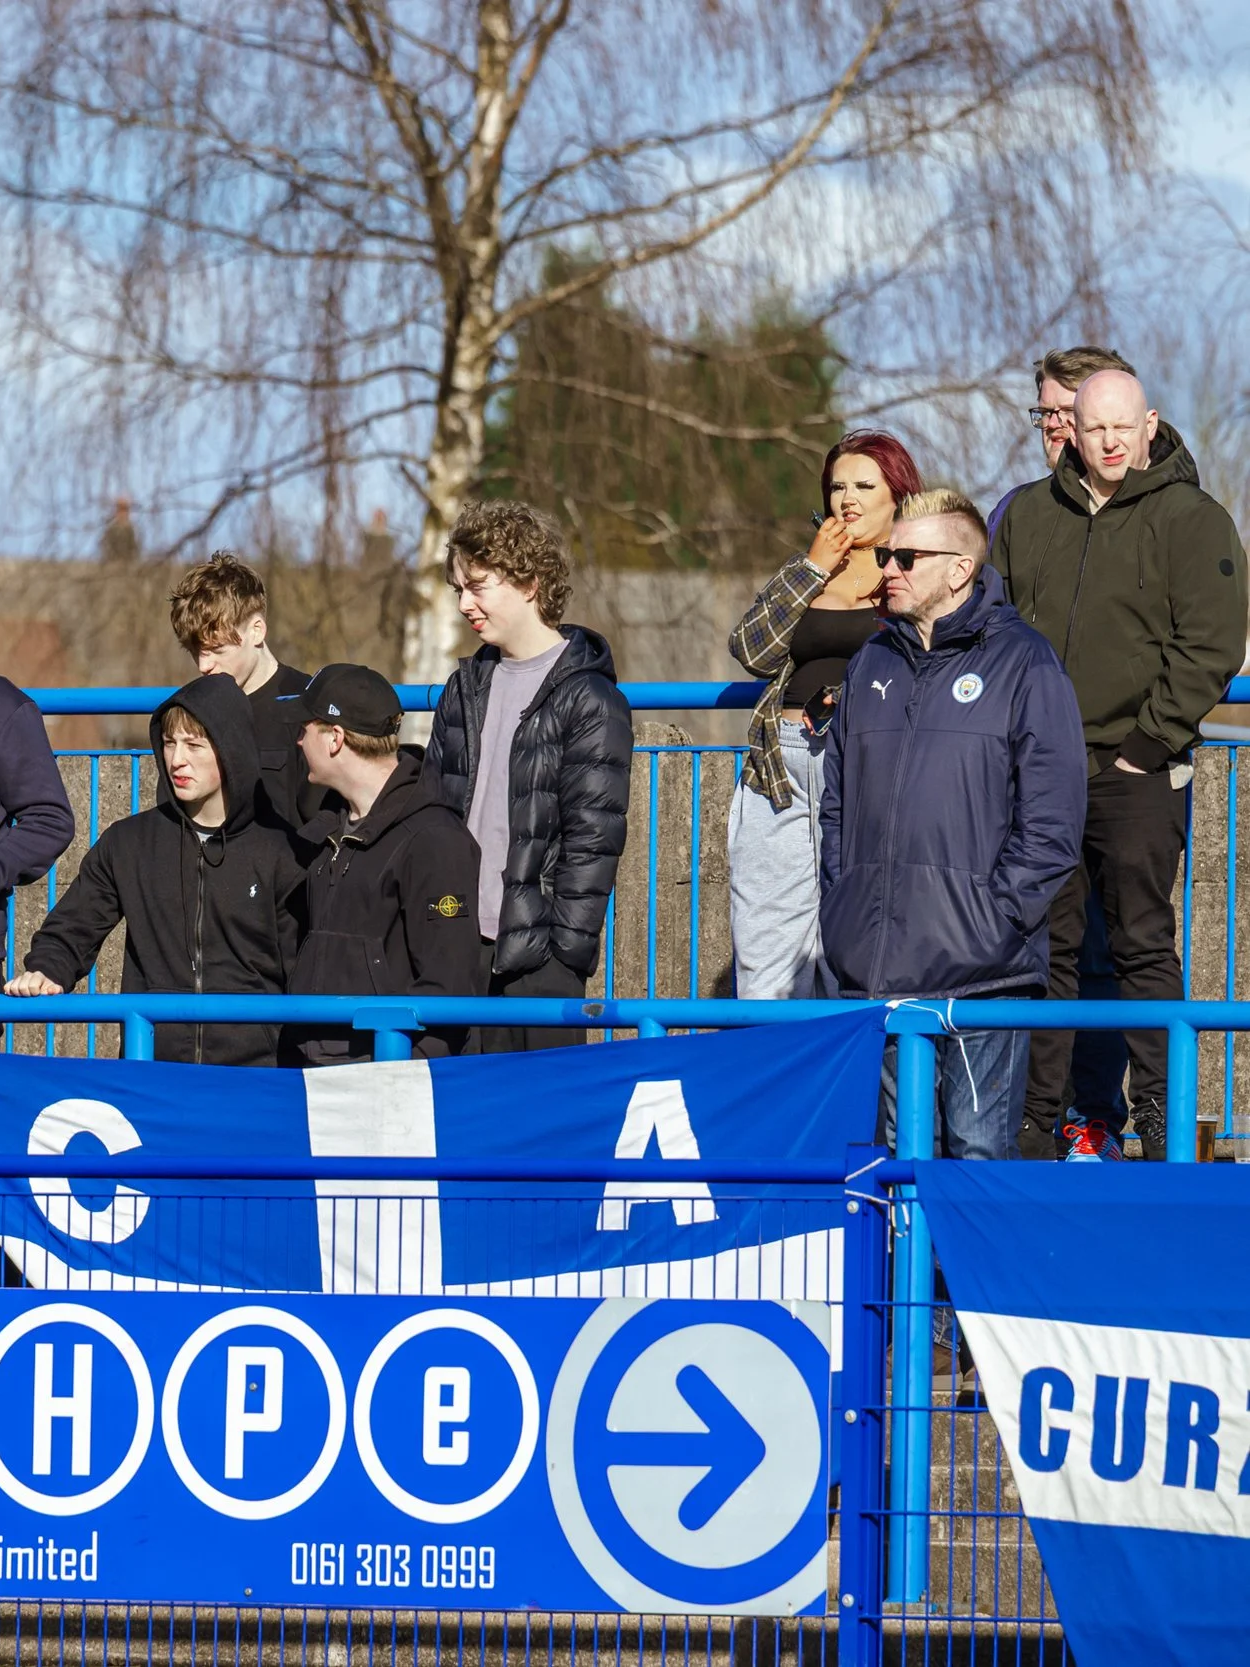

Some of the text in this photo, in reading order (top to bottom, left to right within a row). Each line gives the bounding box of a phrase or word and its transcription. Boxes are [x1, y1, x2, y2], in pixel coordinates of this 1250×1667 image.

[1019, 1366, 1250, 1496] CUR
[291, 1543, 496, 1590] 0161 303 0999
